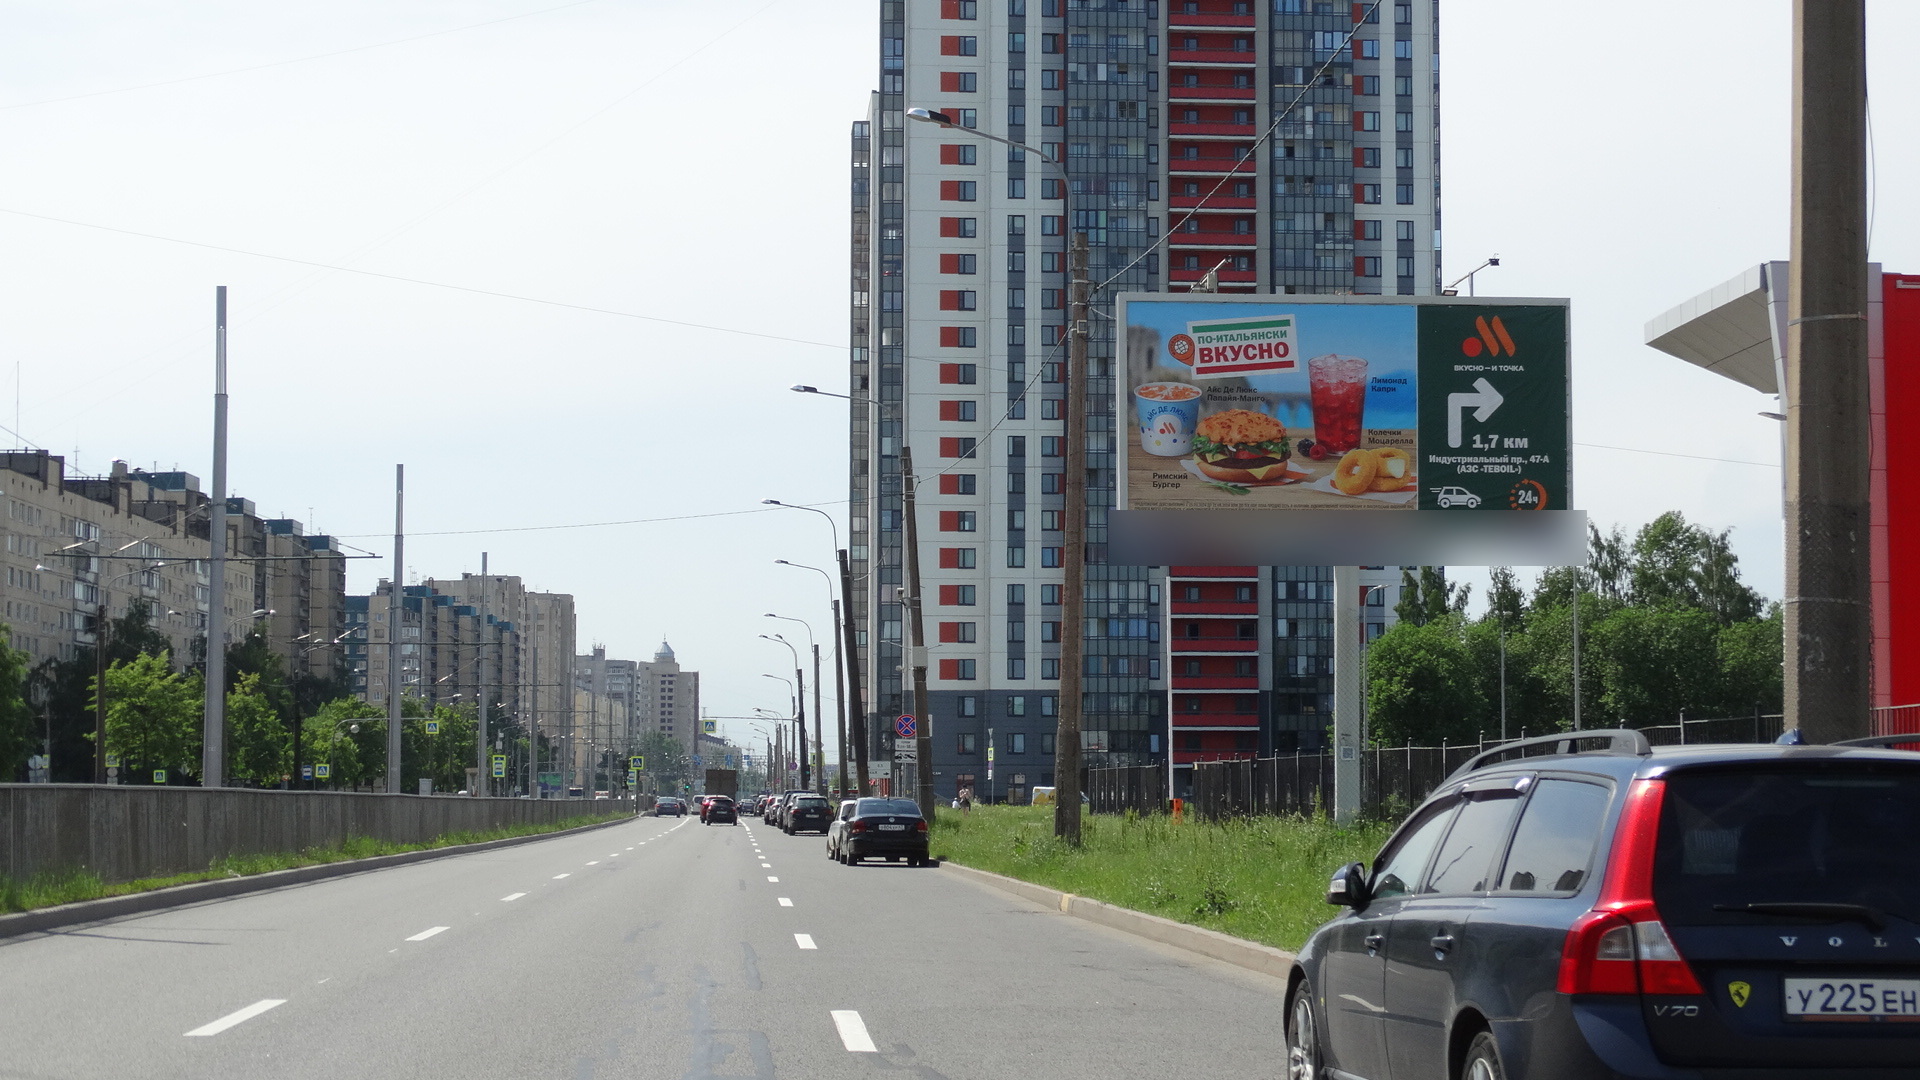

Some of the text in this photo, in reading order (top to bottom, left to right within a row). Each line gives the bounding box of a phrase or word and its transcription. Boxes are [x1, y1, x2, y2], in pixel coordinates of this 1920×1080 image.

[1198, 330, 1287, 344] ПО-ИТАЛЬЯНСКИ
[1199, 341, 1289, 364] ВКУСНО
[1223, 386, 1234, 394] Де
[1207, 394, 1266, 402] Папайя-Манго
[1158, 405, 1168, 414] ДЕ
[1368, 438, 1414, 446] Моцарелла
[1472, 434, 1499, 451] 1,7
[1429, 454, 1509, 464] Индустриальный
[1152, 472, 1188, 480] Римский
[1152, 481, 1181, 489] Бургер
[1654, 1005, 1699, 1017] V70
